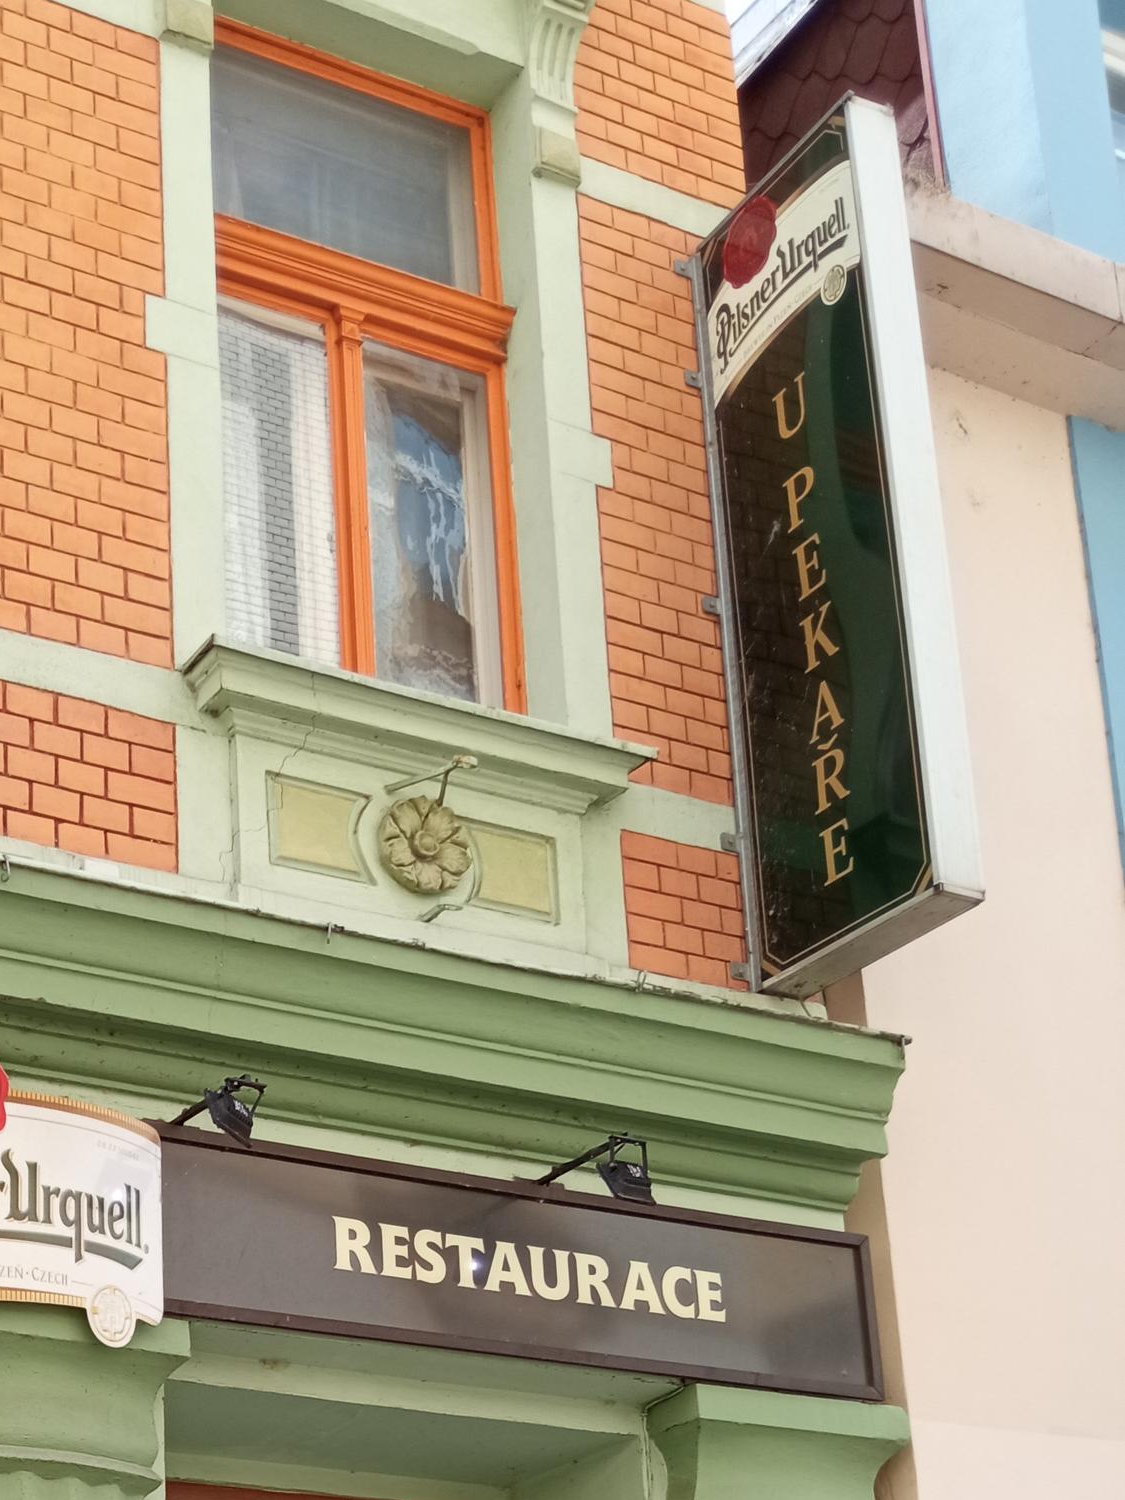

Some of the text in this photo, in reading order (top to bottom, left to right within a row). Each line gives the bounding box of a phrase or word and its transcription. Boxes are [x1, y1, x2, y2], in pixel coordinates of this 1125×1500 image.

[715, 264, 781, 375] Pilsner
[776, 196, 849, 273] Urquell
[772, 371, 807, 440] U
[783, 466, 855, 887] PEKAŘE
[0, 1148, 144, 1264] Urquell
[331, 1215, 727, 1323] RESTAURACE
